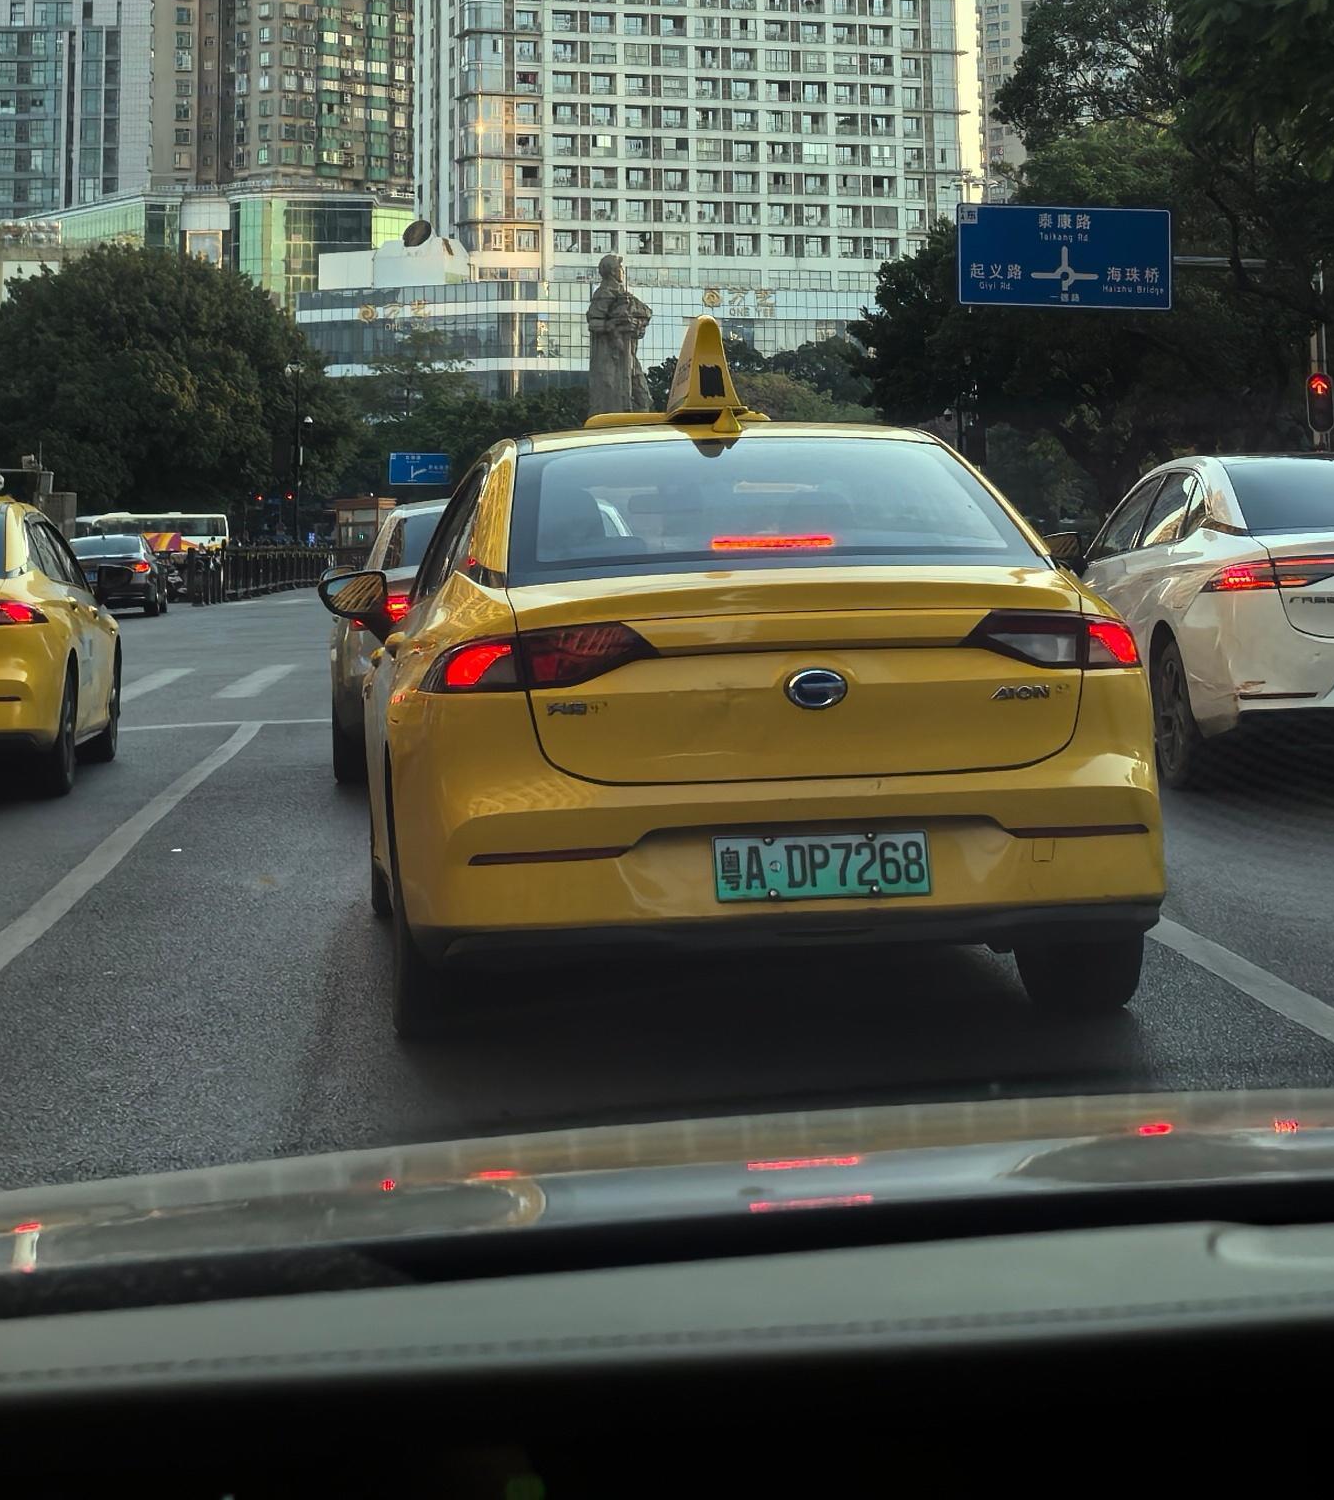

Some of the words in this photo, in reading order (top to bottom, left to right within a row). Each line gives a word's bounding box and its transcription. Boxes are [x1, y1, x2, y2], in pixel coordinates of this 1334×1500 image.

[1038, 213, 1091, 230] 泰康路
[1040, 231, 1073, 243] Taikang
[970, 263, 1022, 280] 起义路
[1106, 266, 1160, 283] 海珠桥
[1102, 284, 1133, 294] Haizhu
[1137, 285, 1165, 296] Bridge
[729, 306, 750, 318] ONE
[991, 684, 1050, 700] AION
